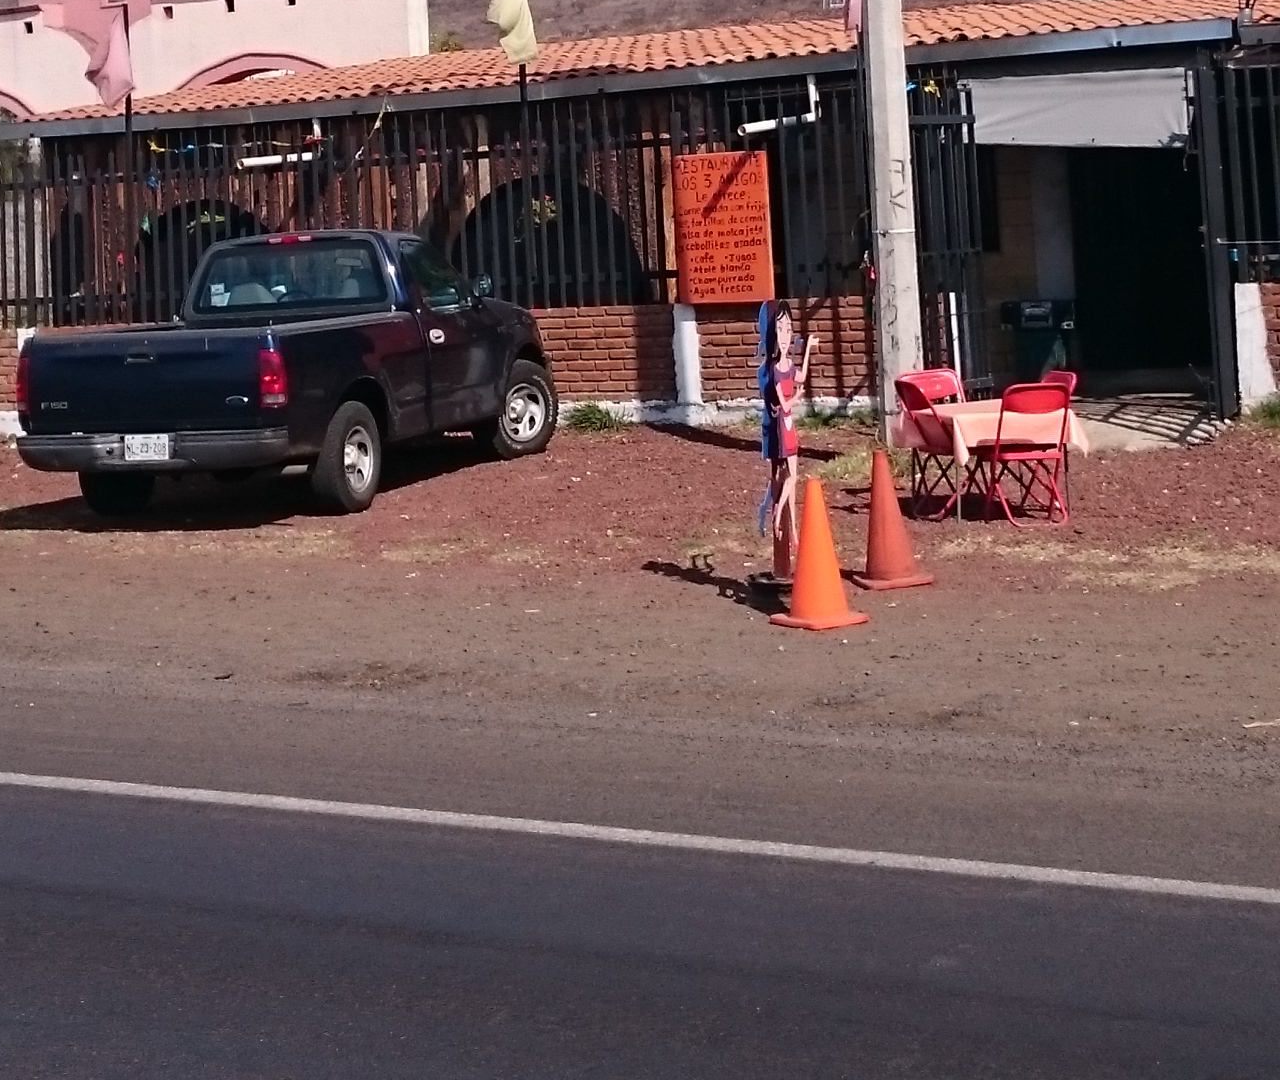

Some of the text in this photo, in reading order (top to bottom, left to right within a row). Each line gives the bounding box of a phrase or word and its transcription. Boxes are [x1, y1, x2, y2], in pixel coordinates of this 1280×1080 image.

[703, 173, 713, 188] 3
[719, 171, 764, 186] AMIGOS
[679, 230, 700, 240] alsa
[703, 229, 713, 238] de
